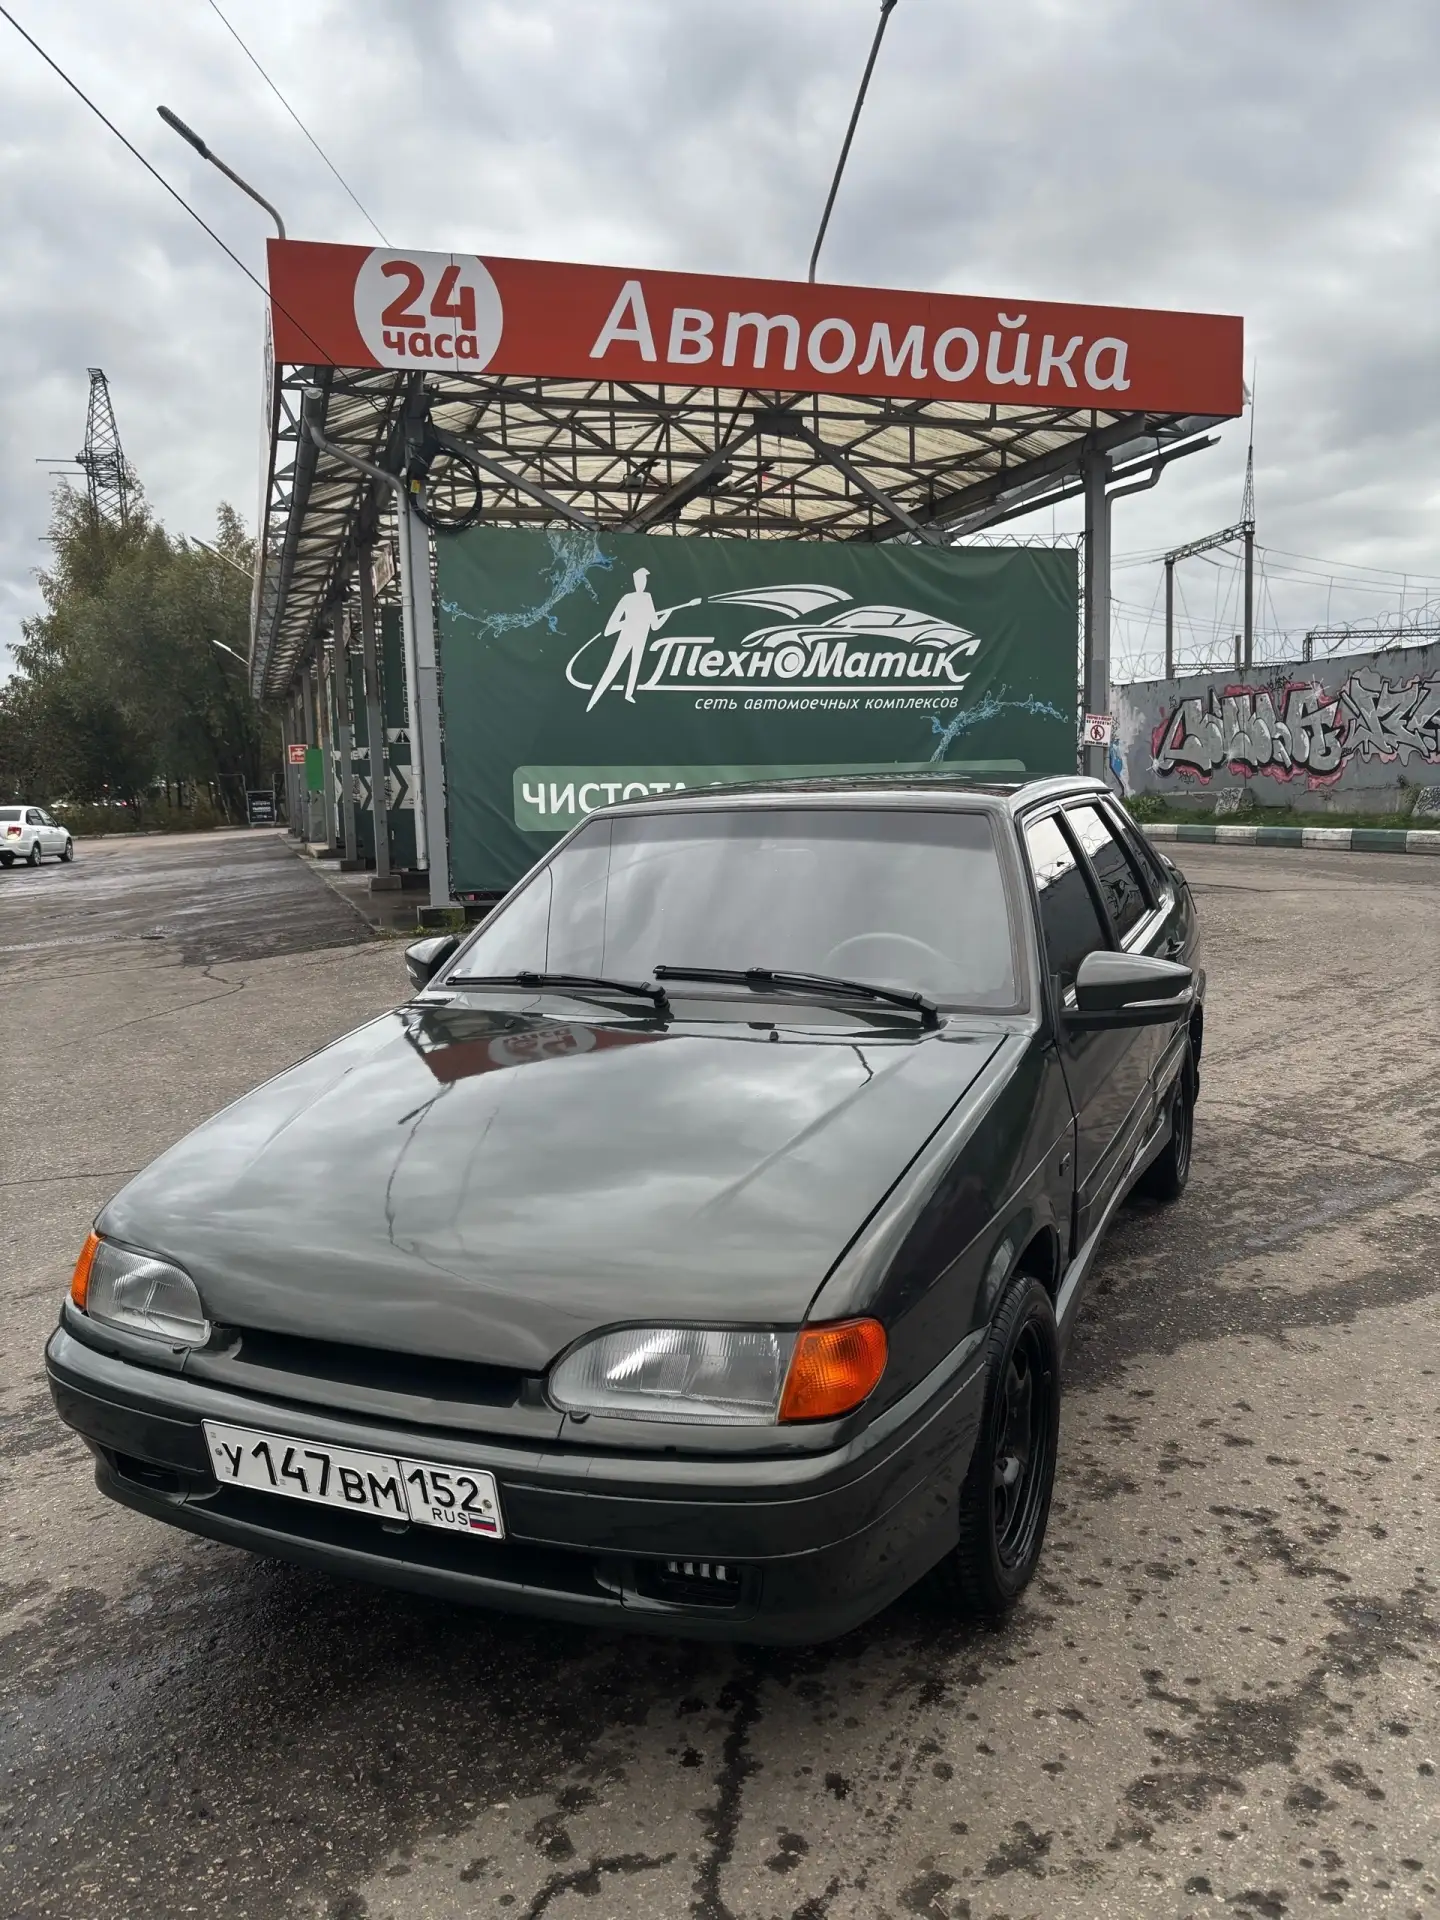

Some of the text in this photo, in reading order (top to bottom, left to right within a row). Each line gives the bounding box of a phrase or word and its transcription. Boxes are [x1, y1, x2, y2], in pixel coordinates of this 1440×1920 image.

[380, 260, 477, 331] 24
[382, 329, 480, 359] часа
[589, 280, 1131, 391] Автомойка
[694, 697, 959, 710] сеть автомоечных комплексов
[407, 1468, 483, 1513] 152
[432, 1507, 469, 1526] RUS
